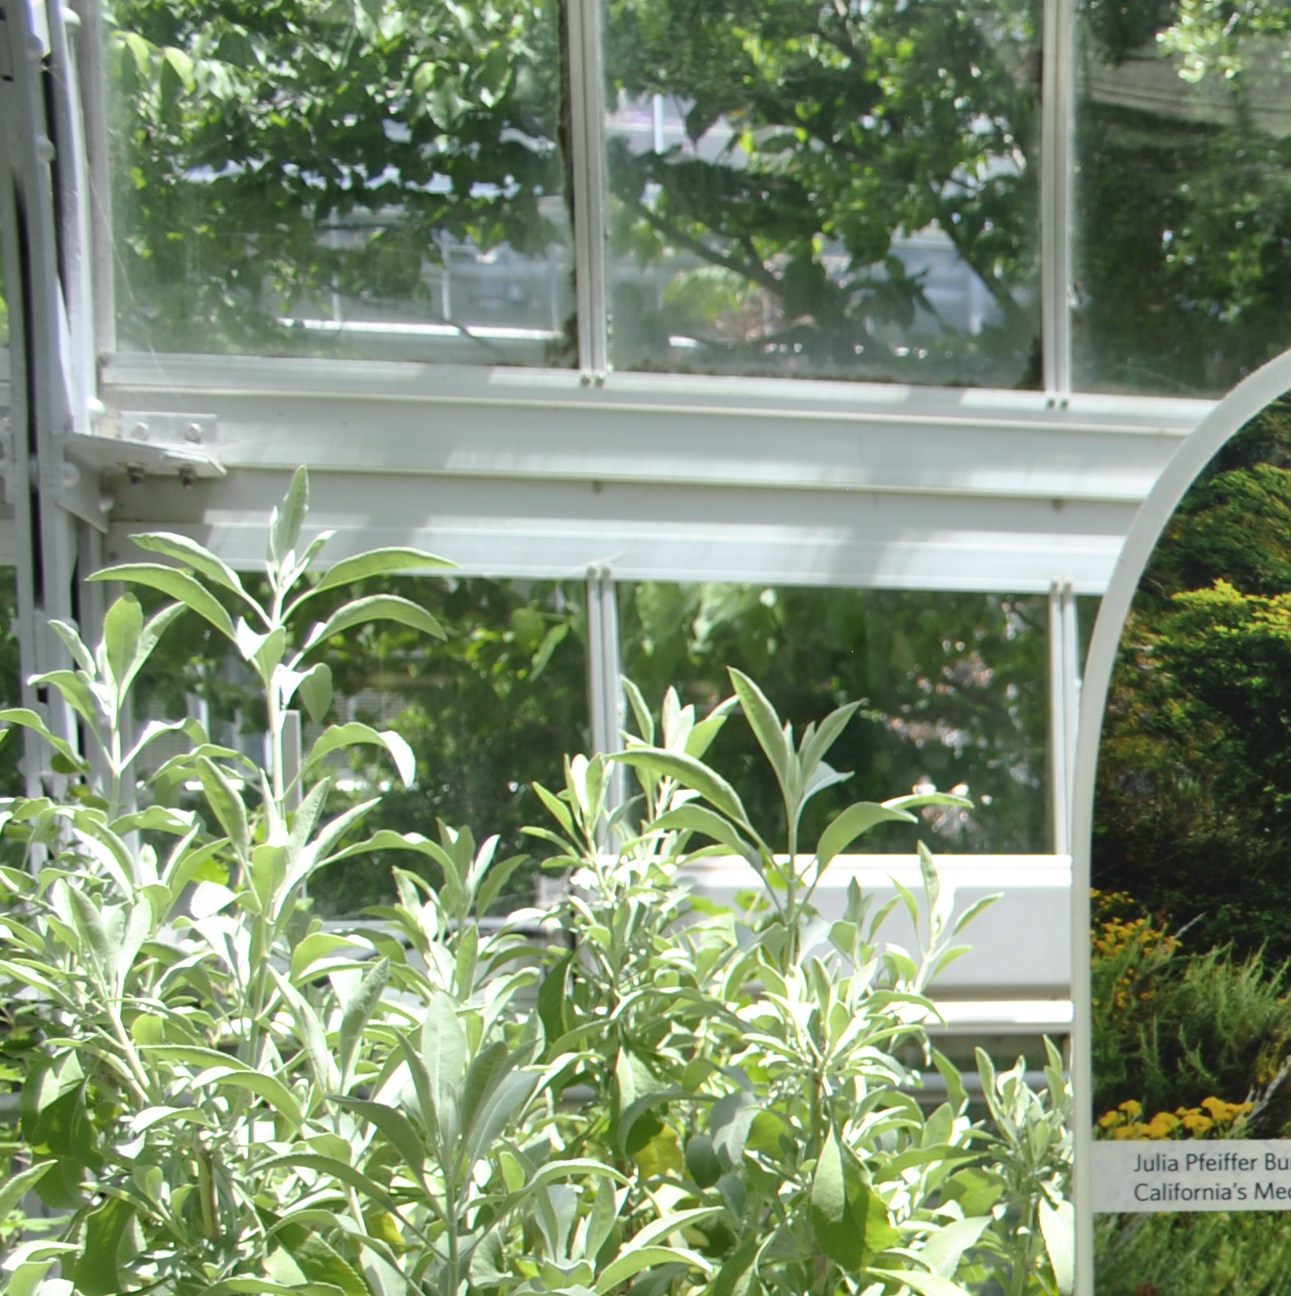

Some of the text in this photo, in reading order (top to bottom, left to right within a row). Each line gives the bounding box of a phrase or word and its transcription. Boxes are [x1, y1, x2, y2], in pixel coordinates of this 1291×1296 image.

[1133, 1154, 1179, 1172] Julia
[1186, 1153, 1258, 1171] Pfeiffer
[1134, 1183, 1247, 1201] California's
